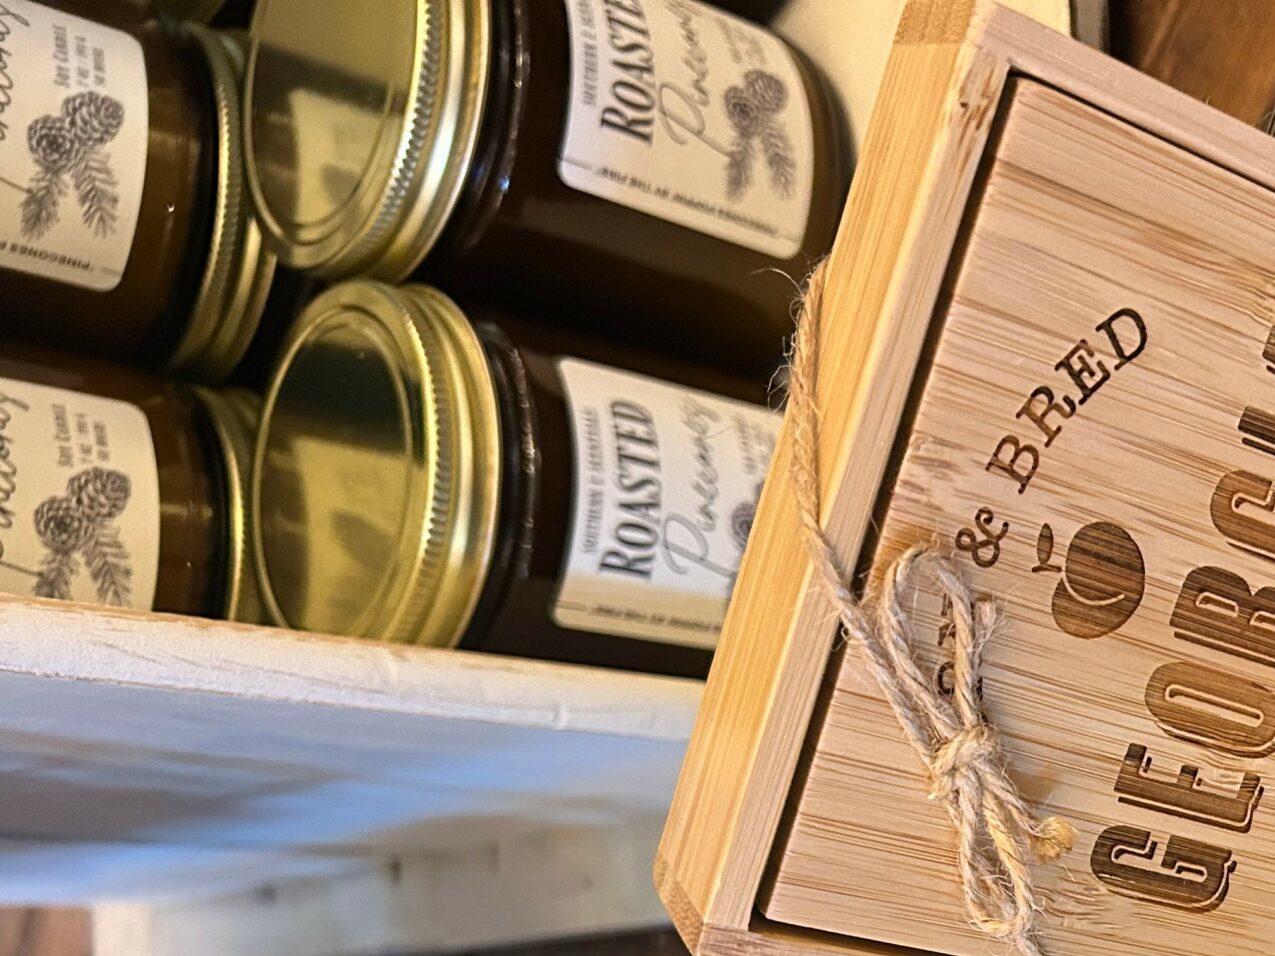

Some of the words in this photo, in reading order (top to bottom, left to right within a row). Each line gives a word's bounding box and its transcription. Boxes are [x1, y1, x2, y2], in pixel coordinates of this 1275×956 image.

[598, 400, 663, 579] ROASTED
[955, 507, 1009, 568] &
[985, 307, 1149, 494] BRED
